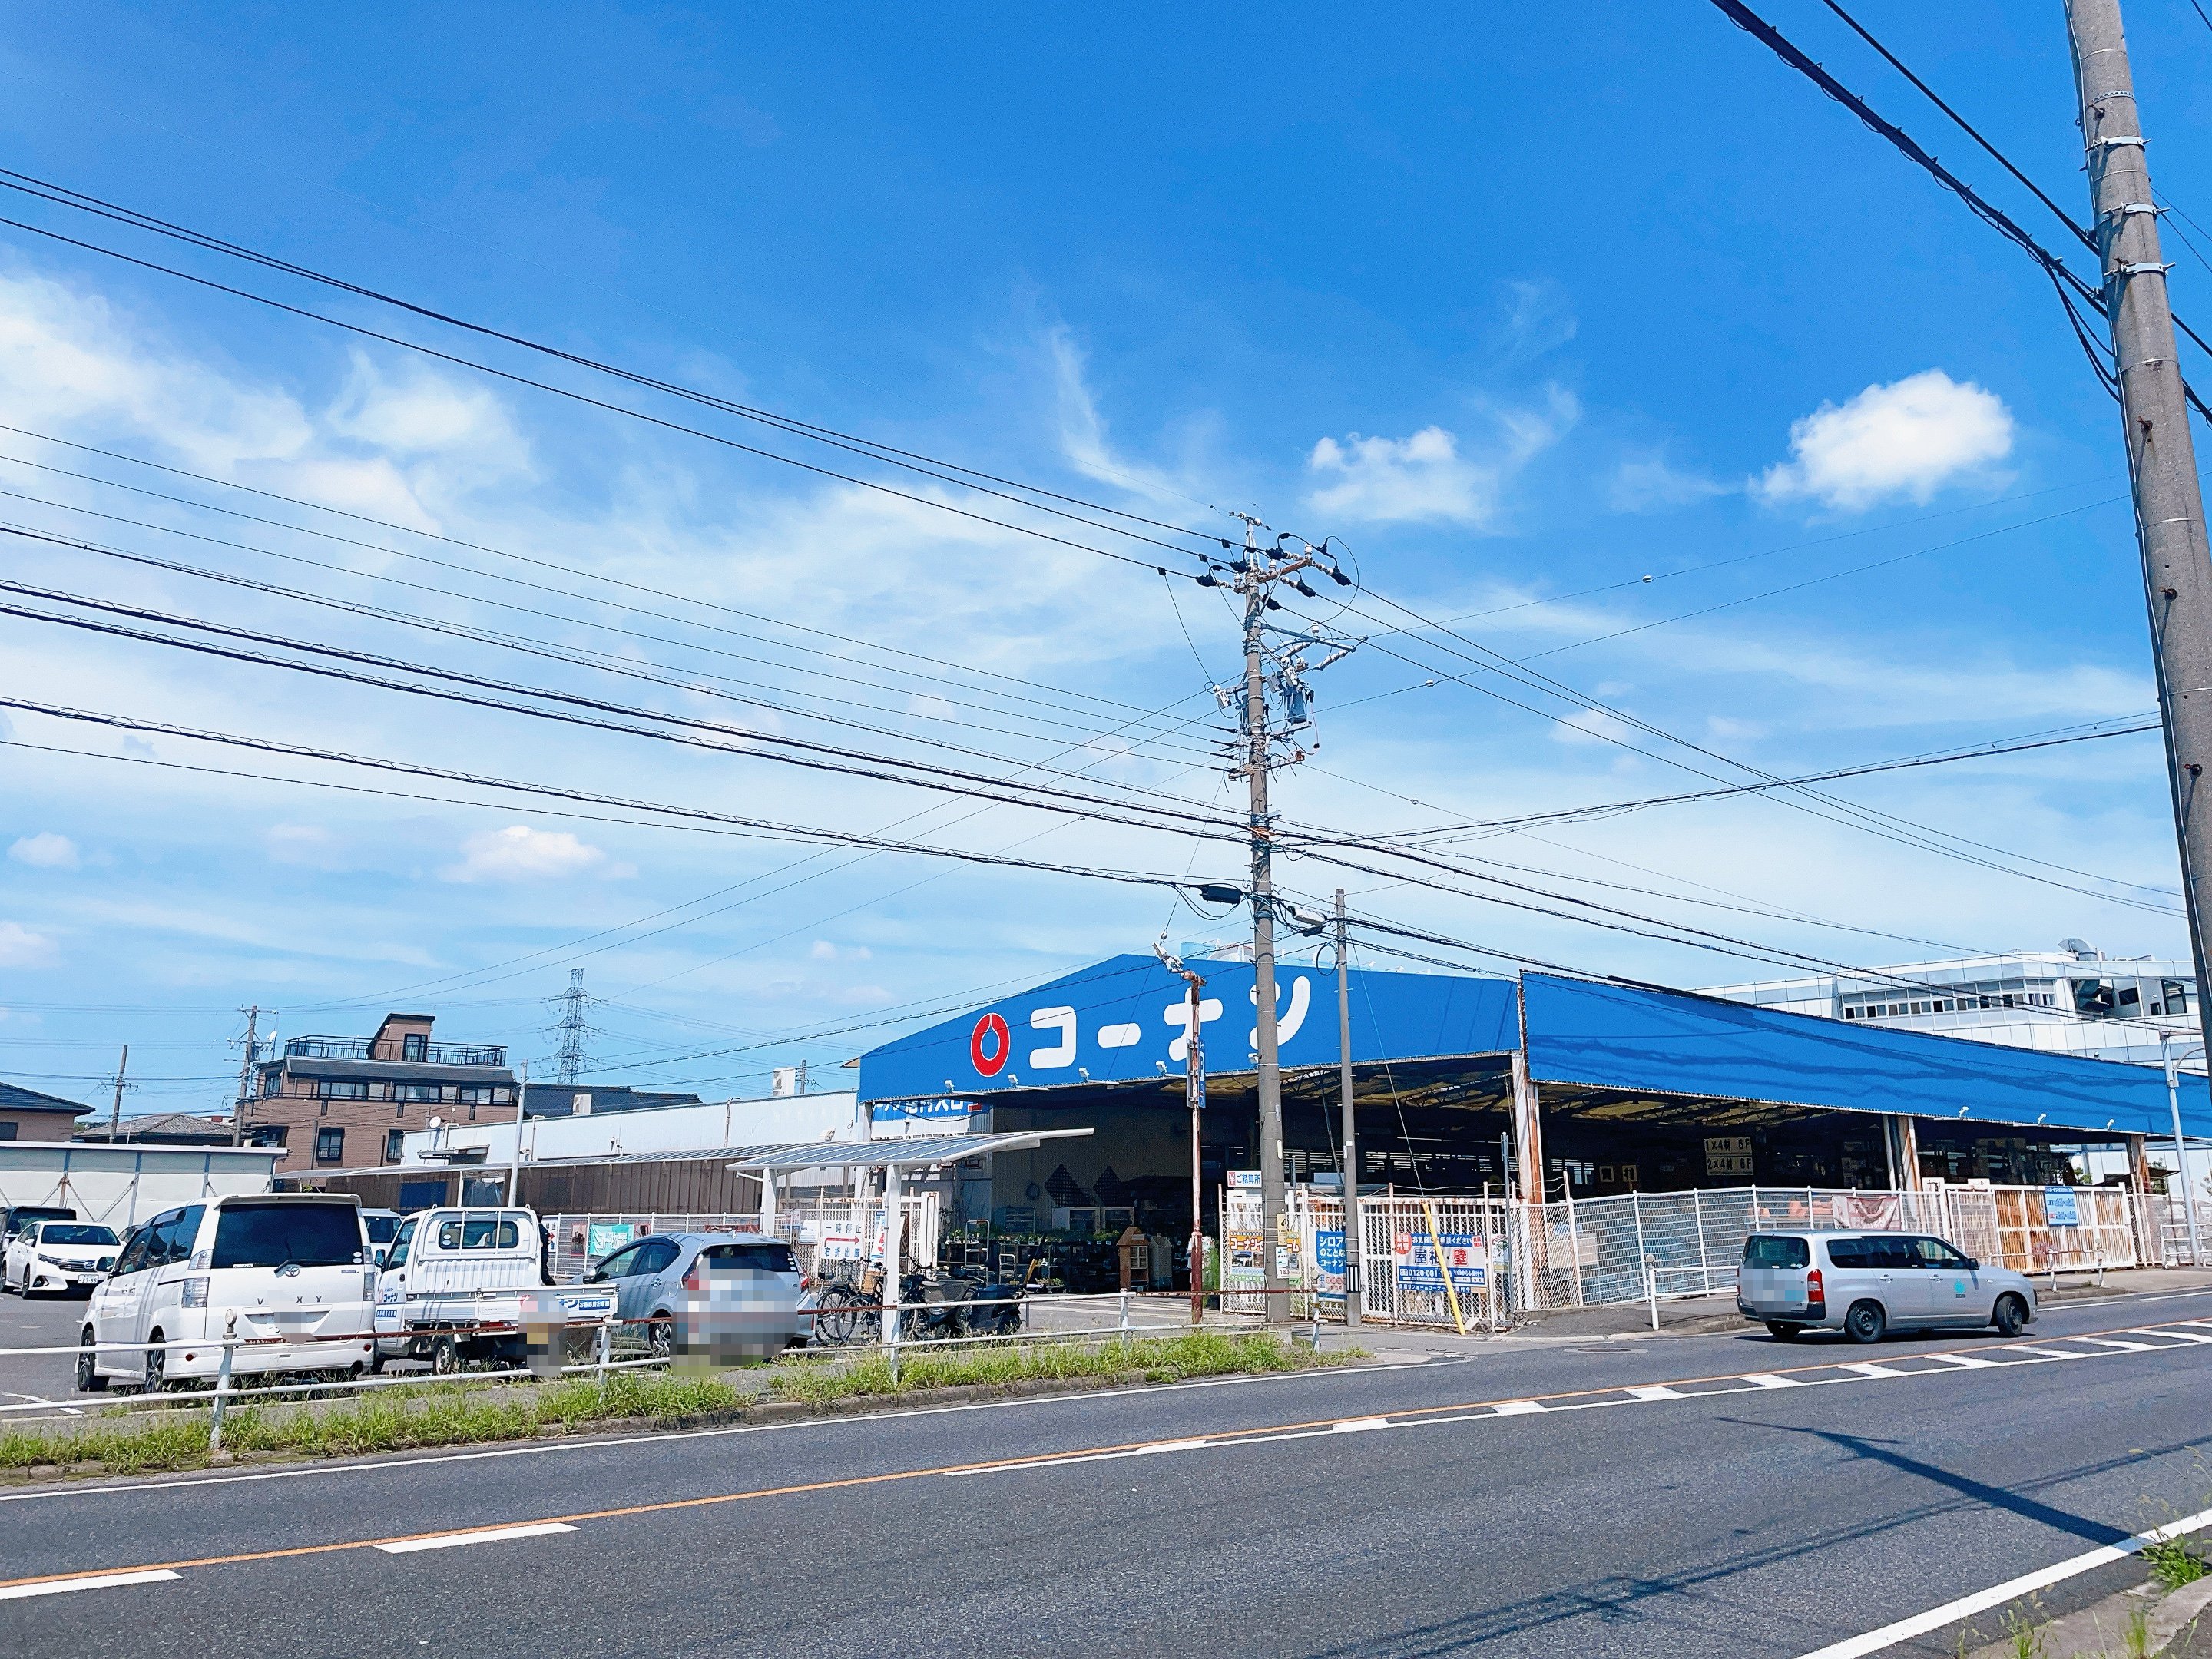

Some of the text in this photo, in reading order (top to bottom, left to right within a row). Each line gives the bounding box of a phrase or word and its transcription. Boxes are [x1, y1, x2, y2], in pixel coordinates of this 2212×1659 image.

[1029, 975, 1311, 1069] コーナン
[1319, 1236, 1344, 1247] シロア
[1320, 1249, 1346, 1257] のことな
[257, 1295, 323, 1305] VXY
